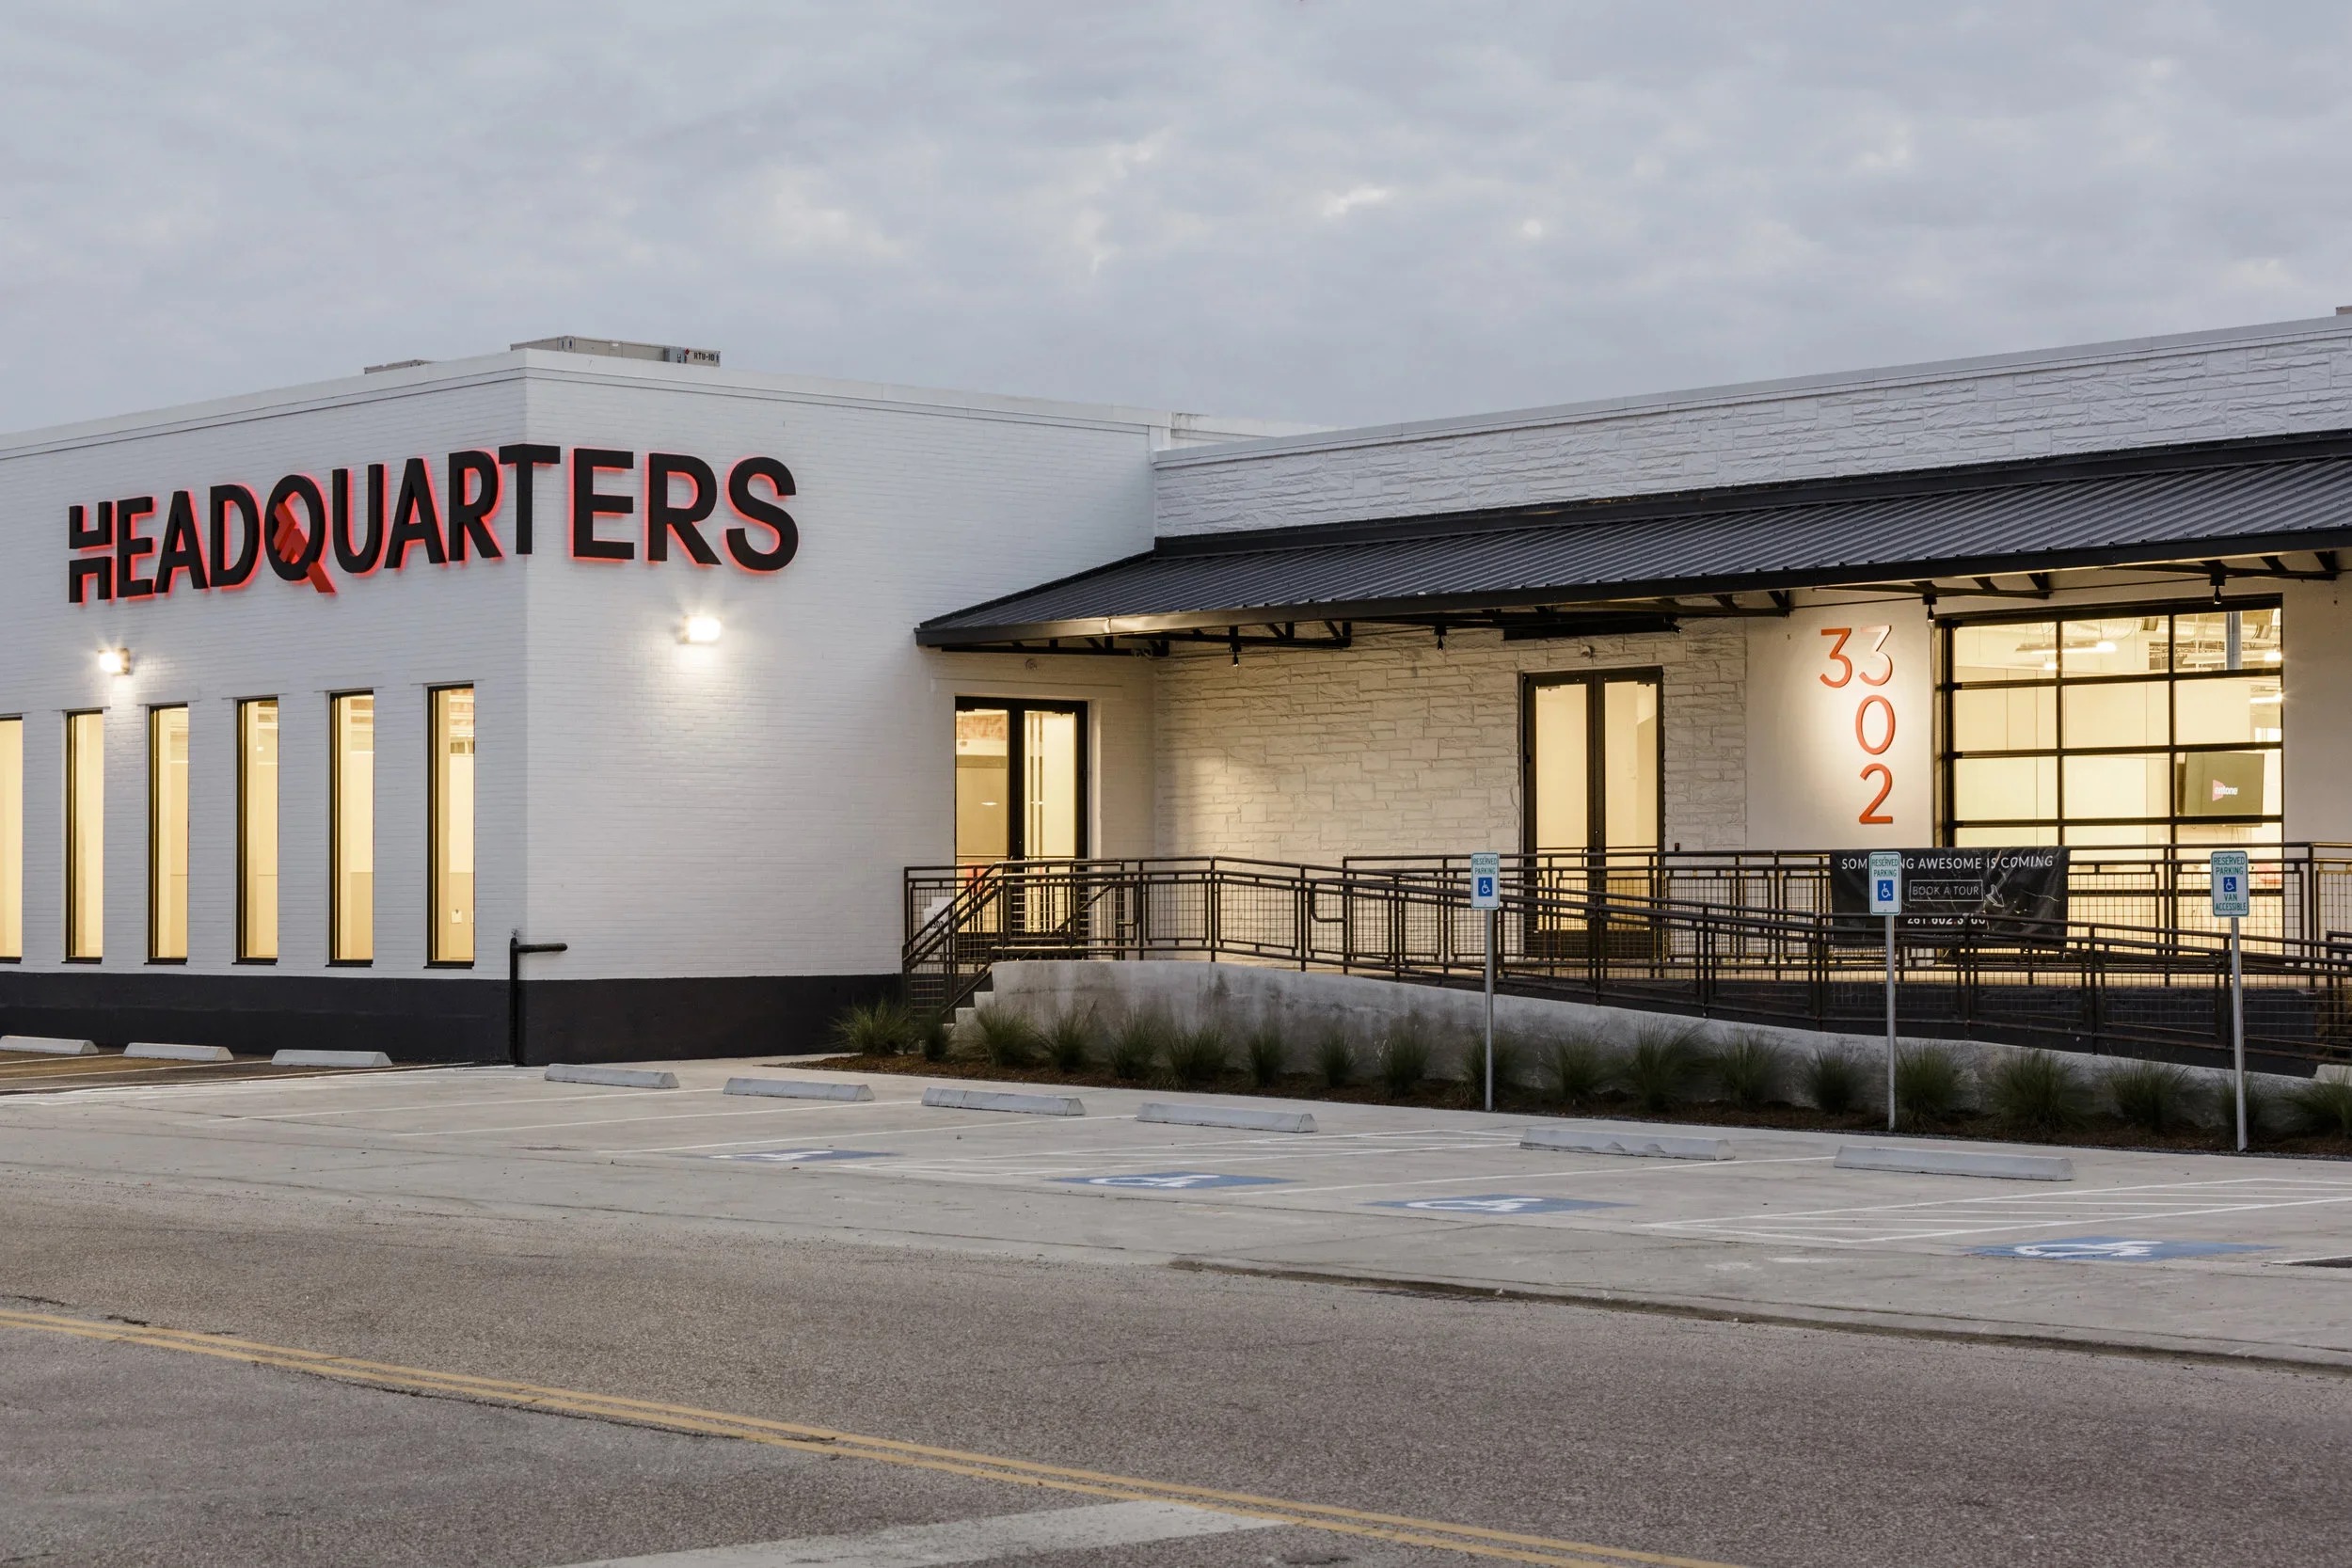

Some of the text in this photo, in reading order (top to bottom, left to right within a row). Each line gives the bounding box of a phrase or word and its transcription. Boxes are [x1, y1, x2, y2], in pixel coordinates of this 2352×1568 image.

[69, 443, 799, 604] HEADQUARTERS
[1472, 857, 1498, 865] RESERVED
[1841, 855, 2054, 870] SOMNG AWESOME IS COMING
[1872, 858, 1899, 866] RESERVED
[2214, 857, 2245, 865] RESERVED
[2216, 866, 2243, 875] PARKING
[1912, 885, 1979, 895] BOOK A TOUR
